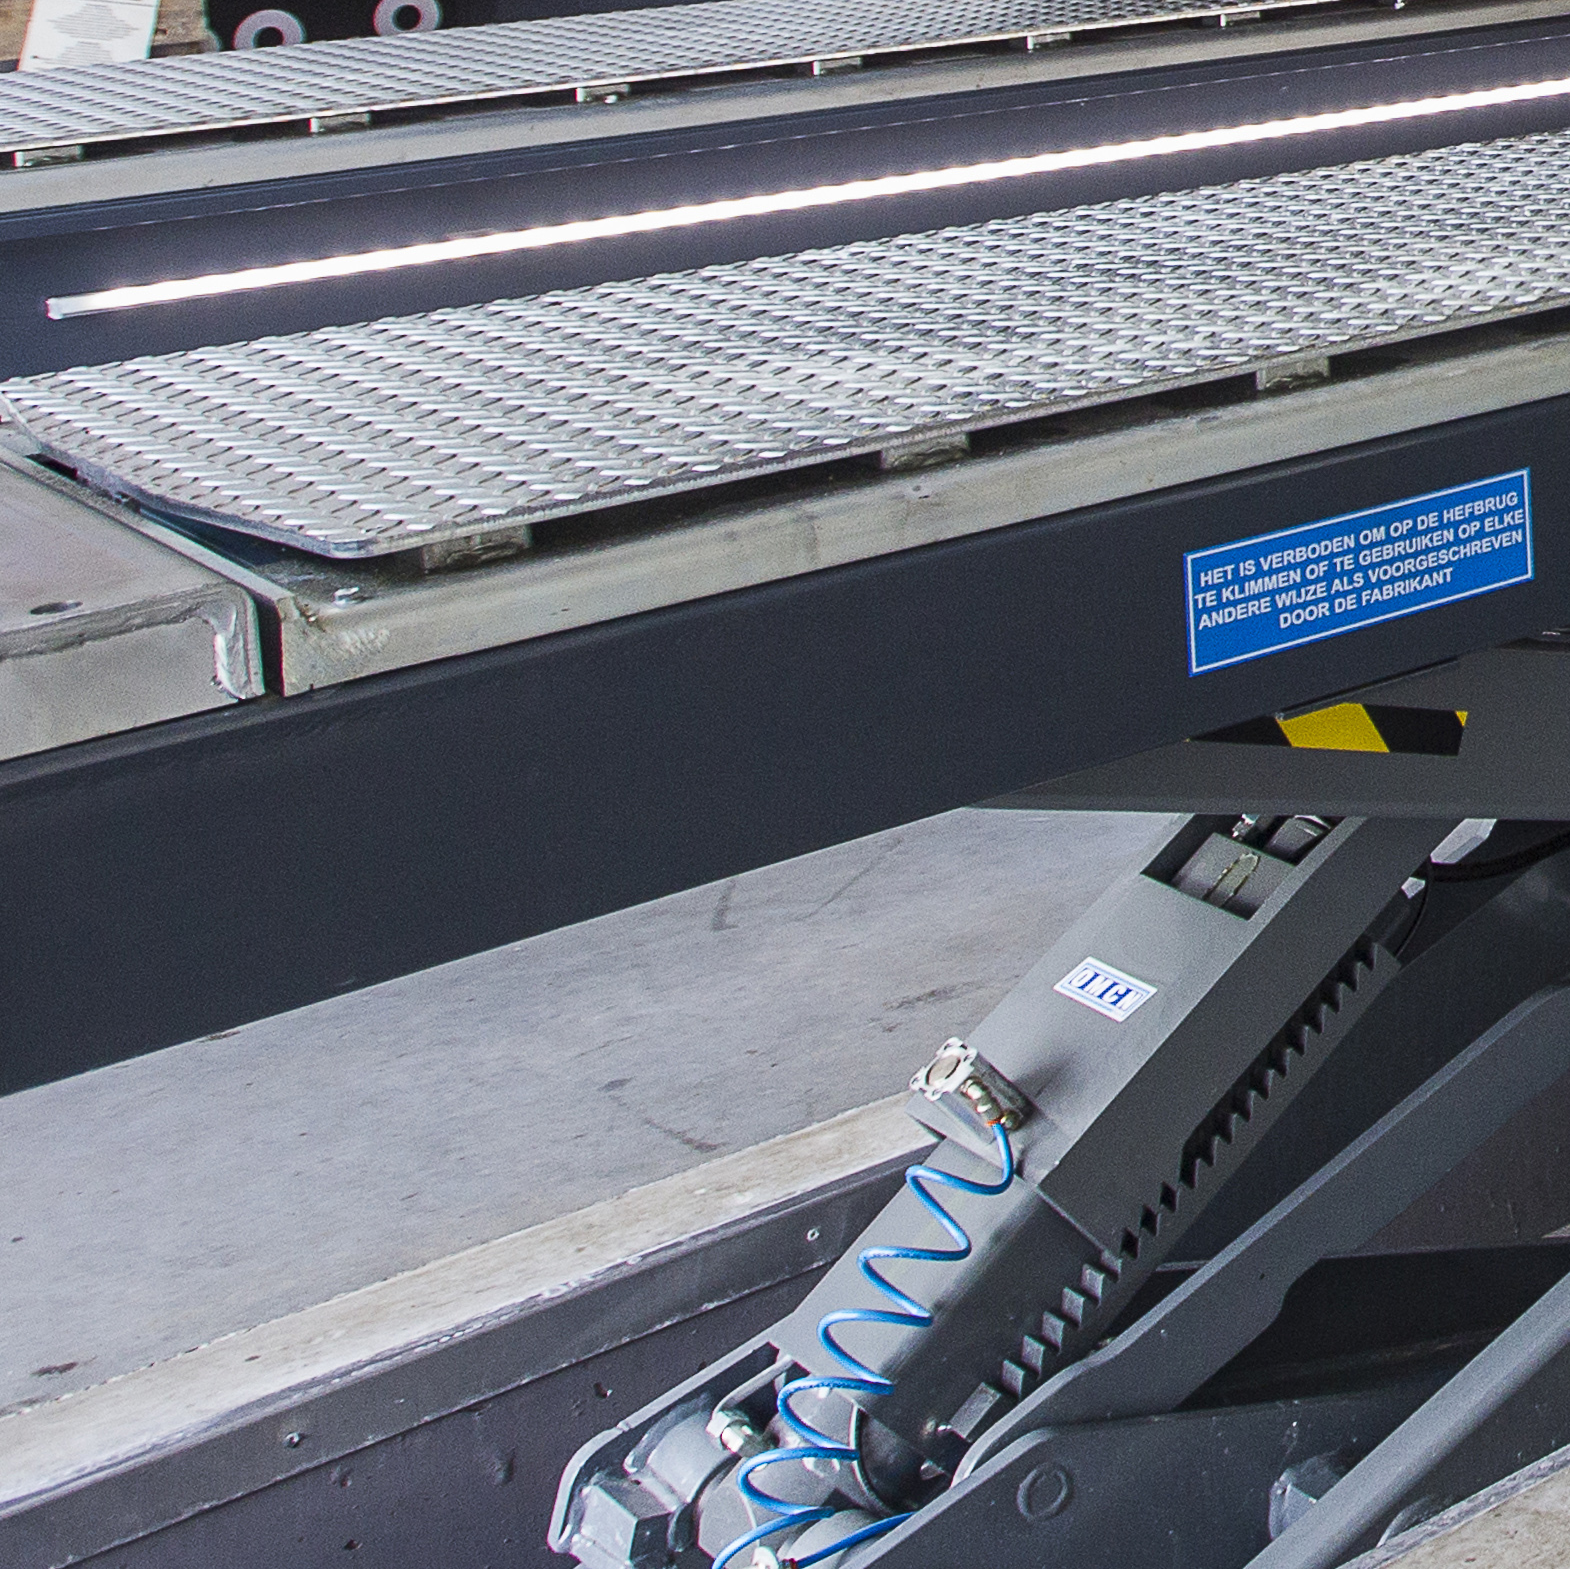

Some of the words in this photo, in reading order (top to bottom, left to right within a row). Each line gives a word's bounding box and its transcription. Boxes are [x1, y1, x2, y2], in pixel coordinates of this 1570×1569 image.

[1194, 590, 1217, 609] TE
[1221, 568, 1301, 603] KLIMMEN
[1305, 561, 1329, 580] OF
[1332, 554, 1355, 572] TE
[1358, 527, 1454, 566] GEBRUIKEN
[1457, 520, 1481, 540] OP
[1484, 509, 1525, 532] ELKE
[1198, 596, 1272, 630] ANDERE
[1274, 581, 1327, 609] WIJZE
[1330, 572, 1364, 595] ALS
[1367, 528, 1523, 584] VOORGESCHREVEN
[1200, 564, 1235, 587] HET
[1239, 559, 1256, 577] IS
[1259, 534, 1355, 571] VERBODEN
[1359, 526, 1386, 545] OM
[1389, 519, 1413, 538] OP
[1417, 512, 1440, 531] DE
[1443, 491, 1519, 524] HEFBRUG
[1279, 601, 1330, 629] DOOR
[1334, 594, 1358, 614] DE
[1361, 567, 1454, 606] FABRIKANT
[1068, 967, 1144, 1012] OMCN
